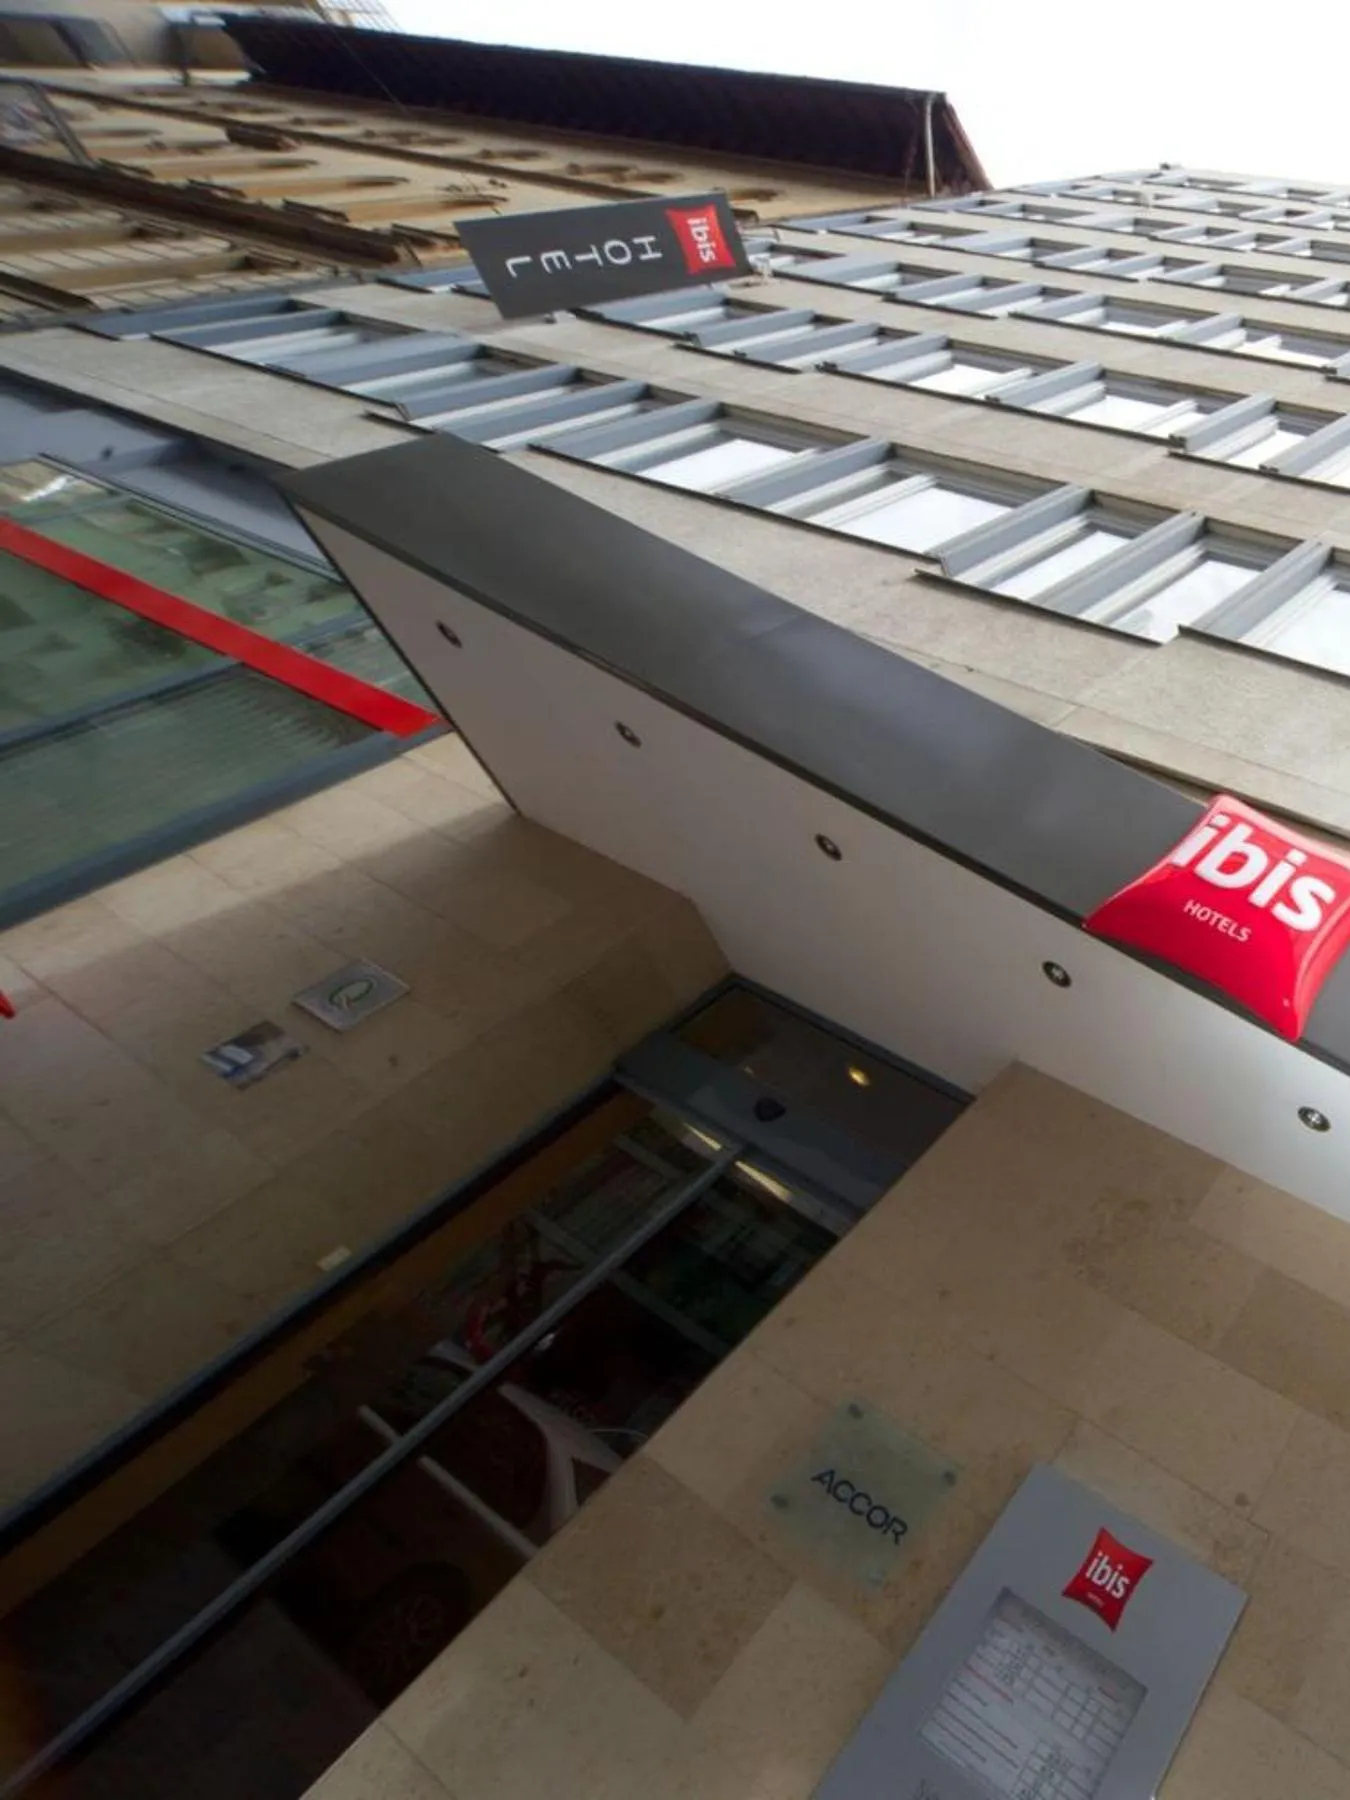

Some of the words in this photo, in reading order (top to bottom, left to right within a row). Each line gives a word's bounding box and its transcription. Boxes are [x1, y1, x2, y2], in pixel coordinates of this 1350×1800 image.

[505, 235, 663, 279] HOTEL
[686, 216, 717, 264] ibis
[1169, 811, 1336, 932] ibis
[1183, 899, 1252, 943] HOTELS
[810, 1468, 908, 1545] ACCOR
[1085, 1550, 1131, 1600] ibis
